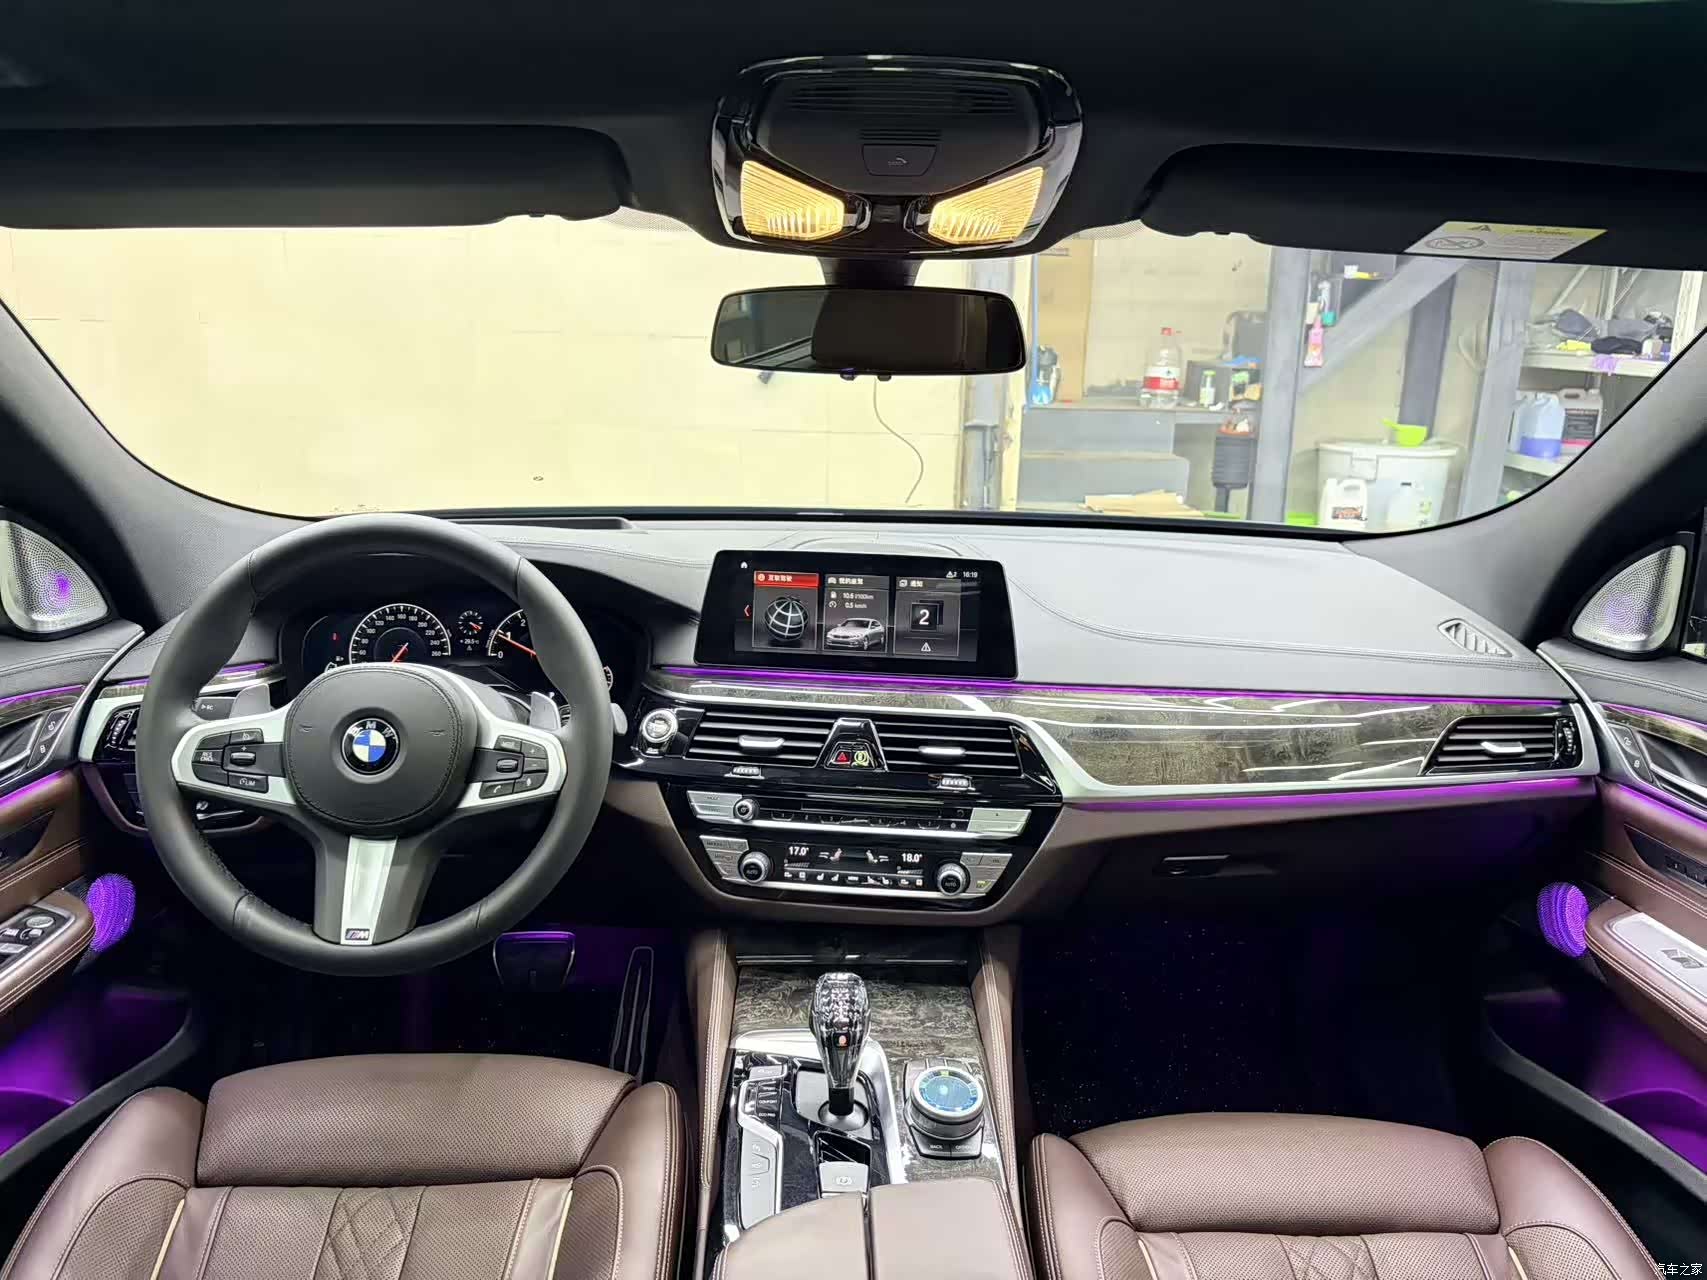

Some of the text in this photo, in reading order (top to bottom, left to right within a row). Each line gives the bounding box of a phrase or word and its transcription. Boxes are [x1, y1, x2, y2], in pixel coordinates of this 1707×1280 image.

[918, 609, 930, 625] 2
[520, 619, 526, 627] 2
[497, 650, 504, 659] 0
